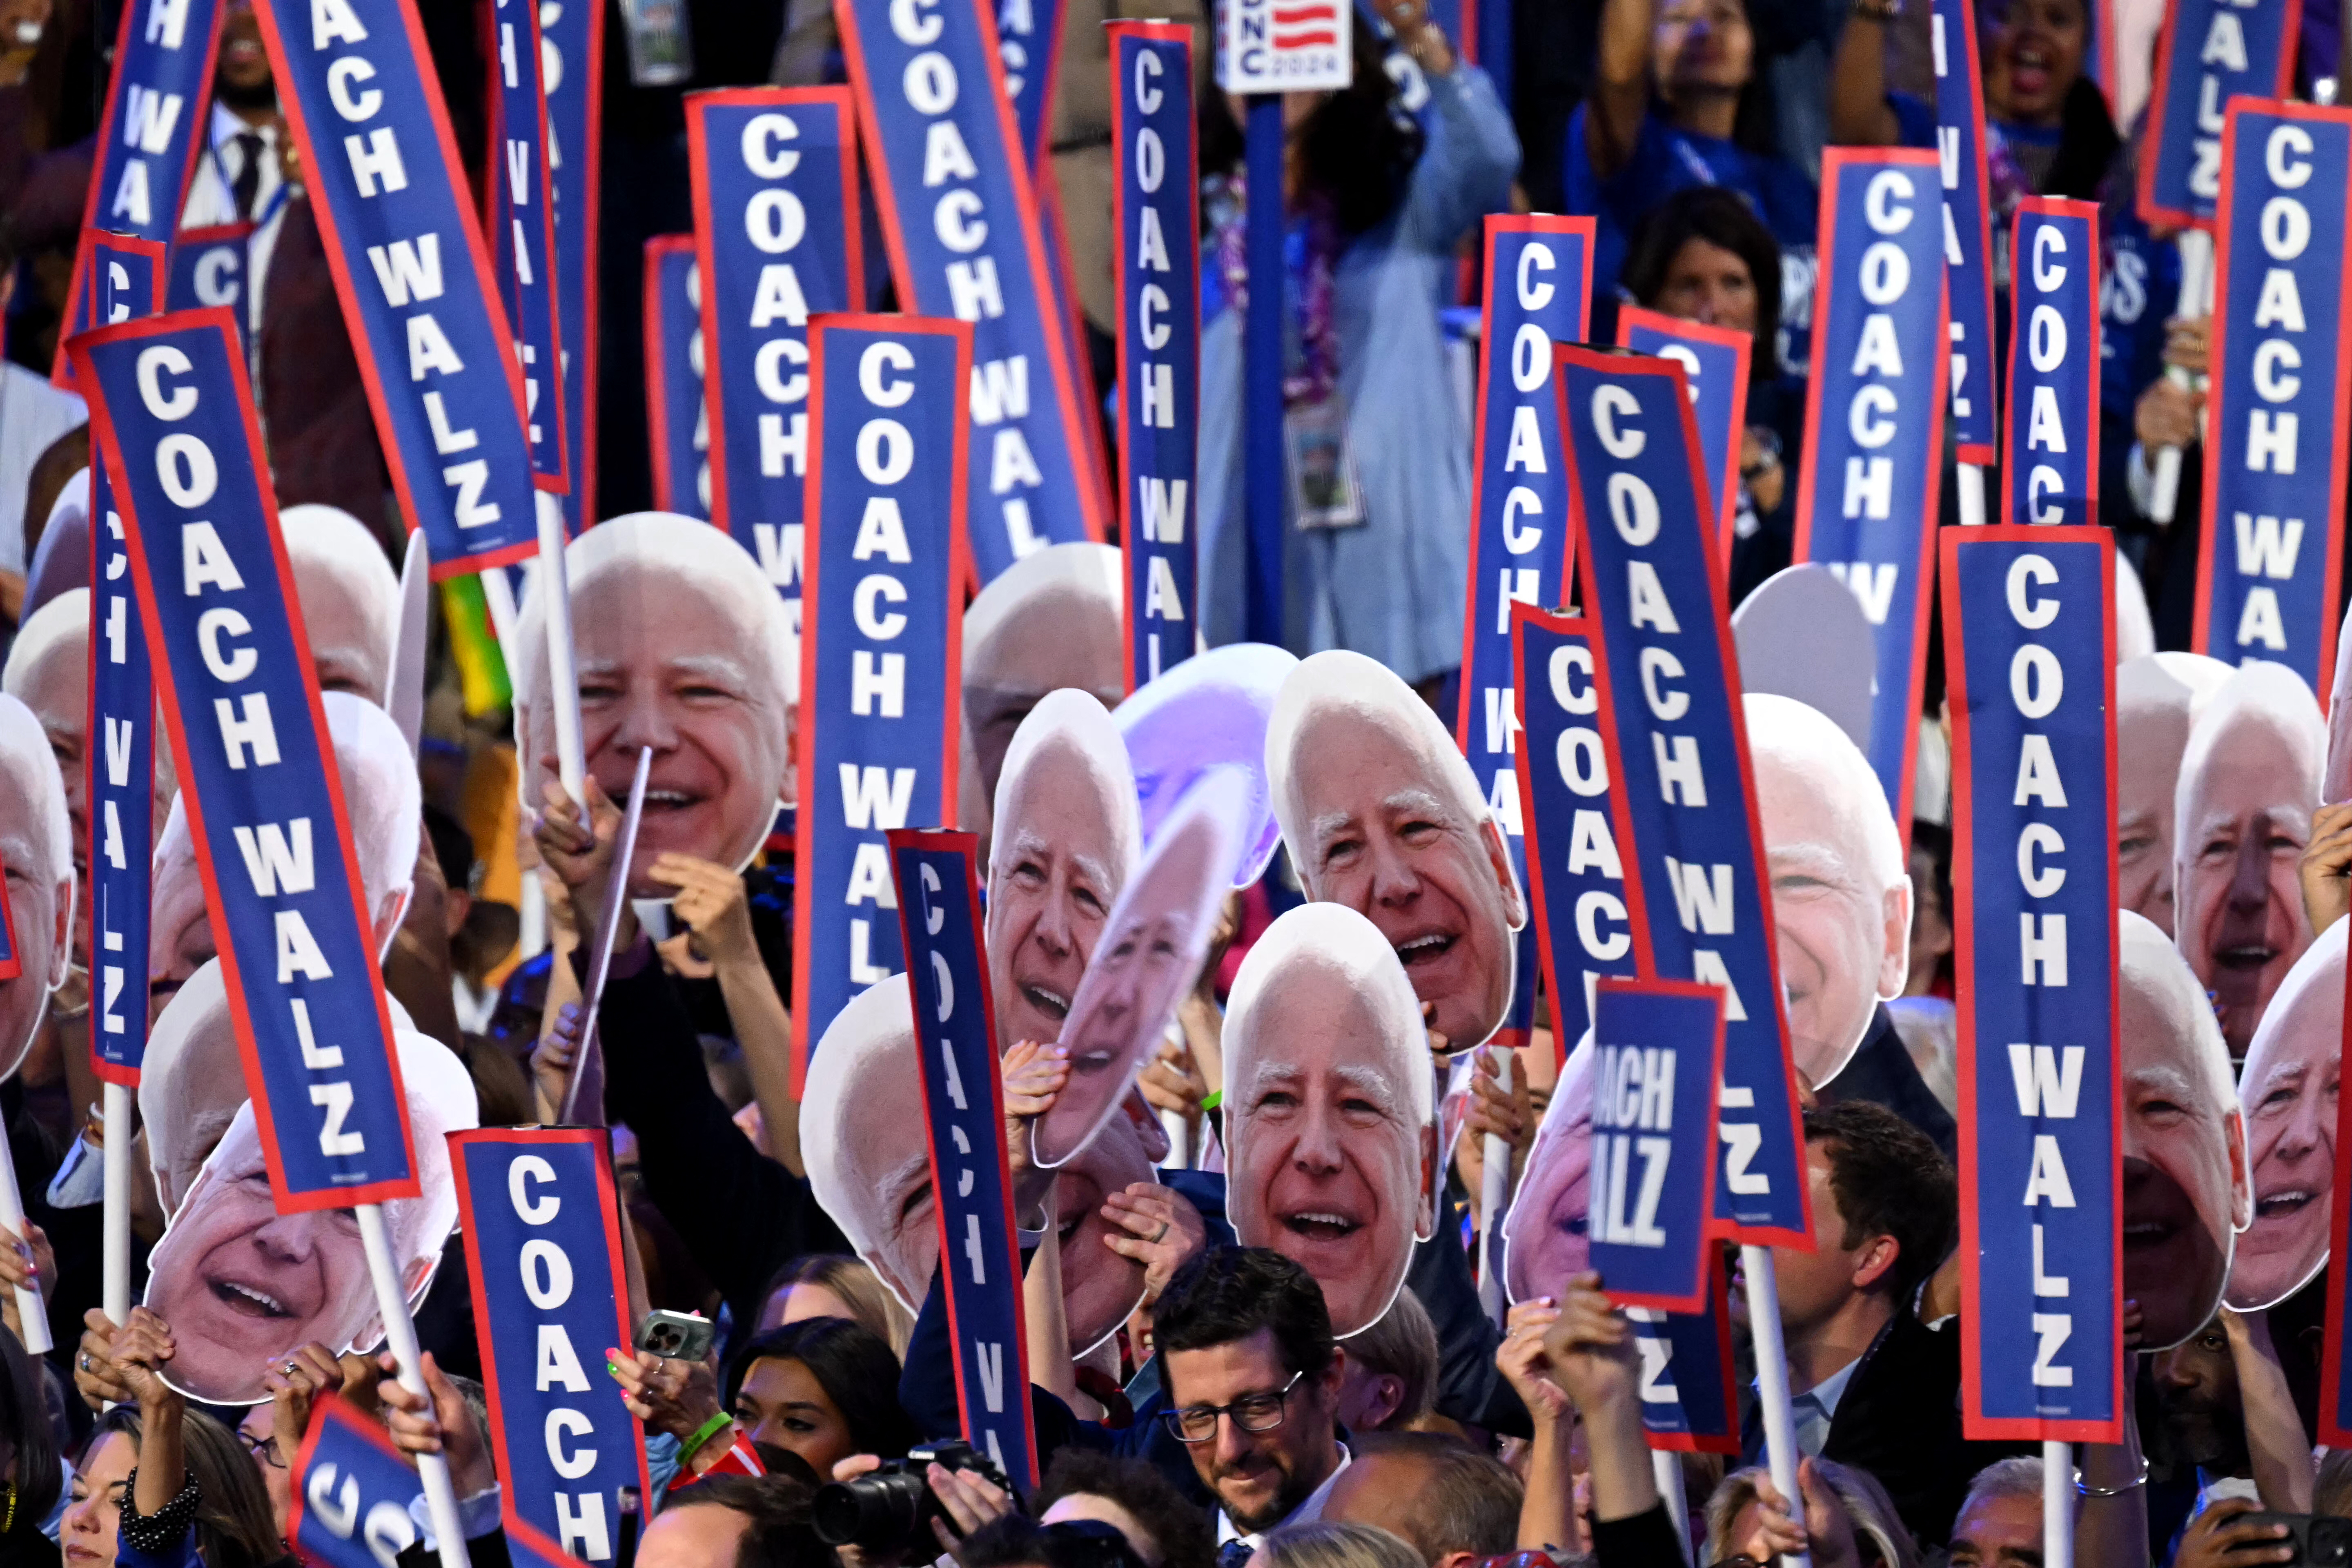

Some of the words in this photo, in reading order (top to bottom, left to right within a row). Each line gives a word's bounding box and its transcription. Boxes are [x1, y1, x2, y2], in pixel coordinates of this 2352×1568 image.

[1240, 0, 1265, 75] NC
[308, 0, 408, 198] ACH
[368, 233, 500, 529] WALZ
[741, 114, 808, 477] COACH
[889, 0, 1004, 321] COACH
[969, 355, 1050, 559] WAL
[1135, 49, 1174, 428] COACH
[1843, 170, 1914, 519] COACH
[2028, 225, 2067, 524] COAC
[2245, 126, 2313, 474] COACH
[852, 342, 915, 718] COACH
[1497, 242, 1555, 634] COACH
[1592, 385, 1707, 806] COACH
[136, 345, 281, 769] COACH
[233, 817, 365, 1156] WALZ
[2006, 554, 2068, 987] COACH
[508, 1155, 612, 1561] COACH
[2008, 1044, 2085, 1386] WALZ
